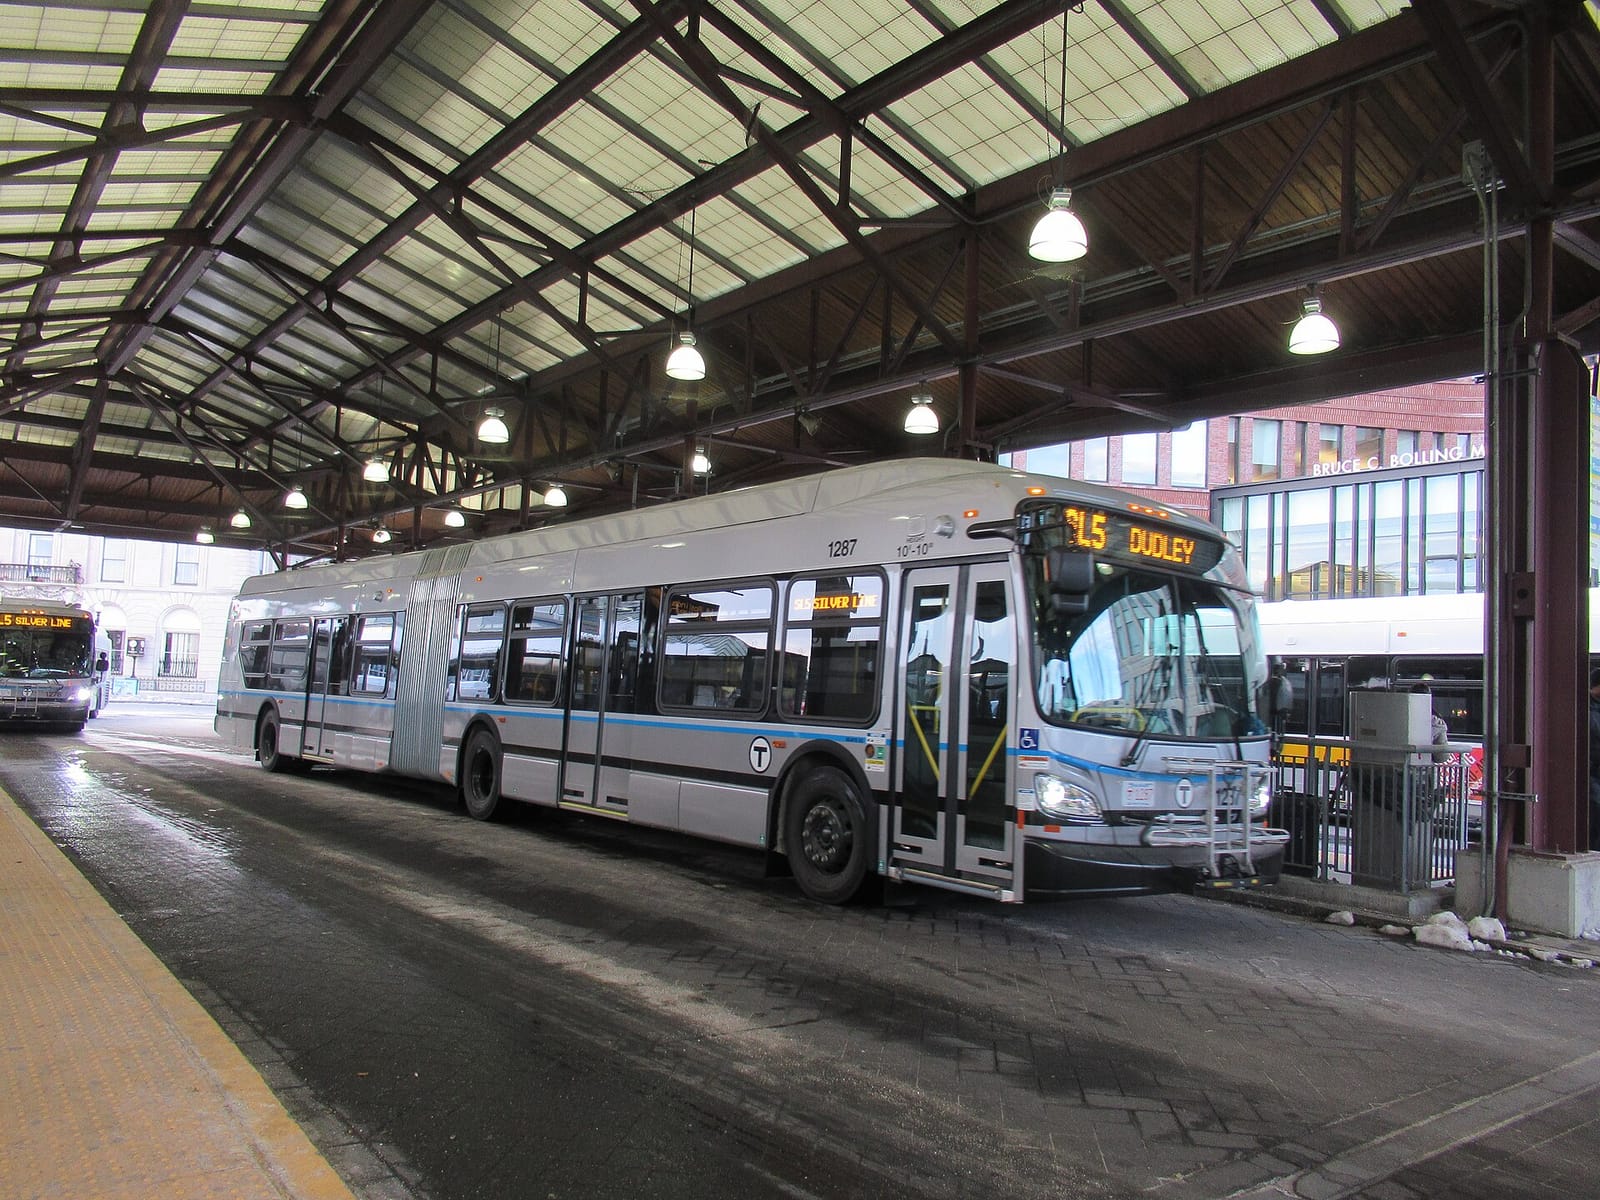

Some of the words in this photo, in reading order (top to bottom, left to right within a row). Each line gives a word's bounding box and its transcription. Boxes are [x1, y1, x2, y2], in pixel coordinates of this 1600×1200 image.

[1313, 459, 1360, 476] BRUCE
[1367, 457, 1384, 470] C.
[1390, 446, 1463, 468] BOLLING
[828, 539, 857, 557] 1287
[1129, 527, 1196, 564] DUDLEY
[813, 596, 849, 610] SILVER
[851, 594, 877, 609] LINE
[15, 616, 48, 626] SILVER
[51, 618, 72, 628] LINE
